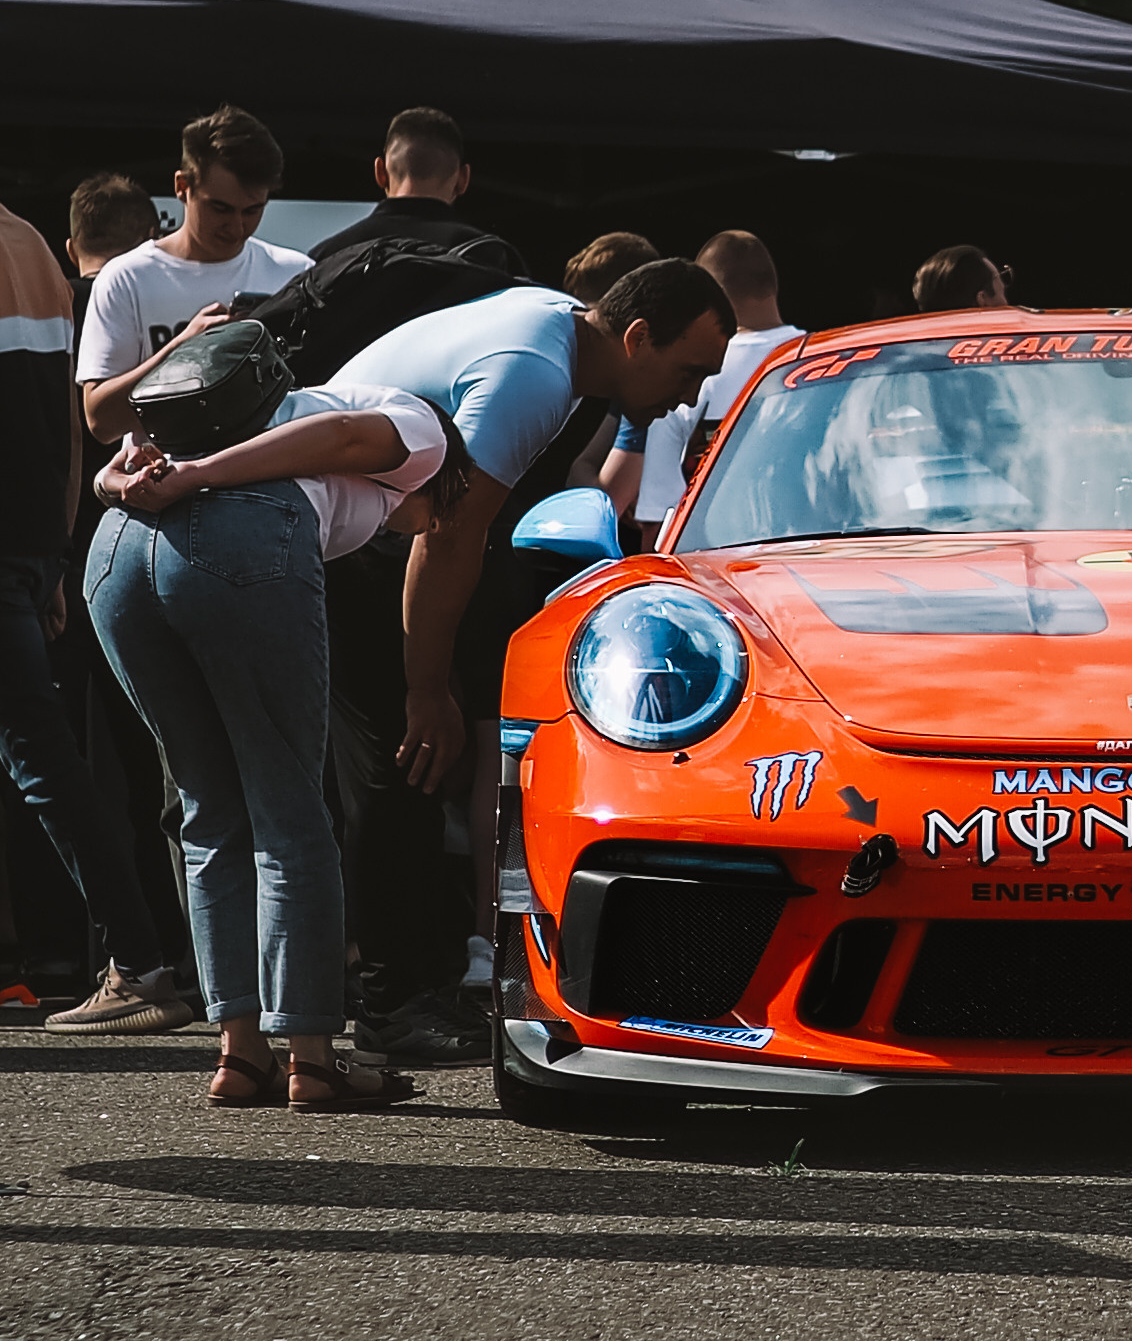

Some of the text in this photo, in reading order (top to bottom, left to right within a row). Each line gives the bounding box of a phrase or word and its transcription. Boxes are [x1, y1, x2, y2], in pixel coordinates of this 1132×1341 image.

[947, 336, 1078, 359] GRAN
[952, 356, 993, 365] THE
[1000, 354, 1054, 362] REAL
[972, 882, 1123, 902] ENERGY
[661, 1022, 764, 1042] MICHELIN
